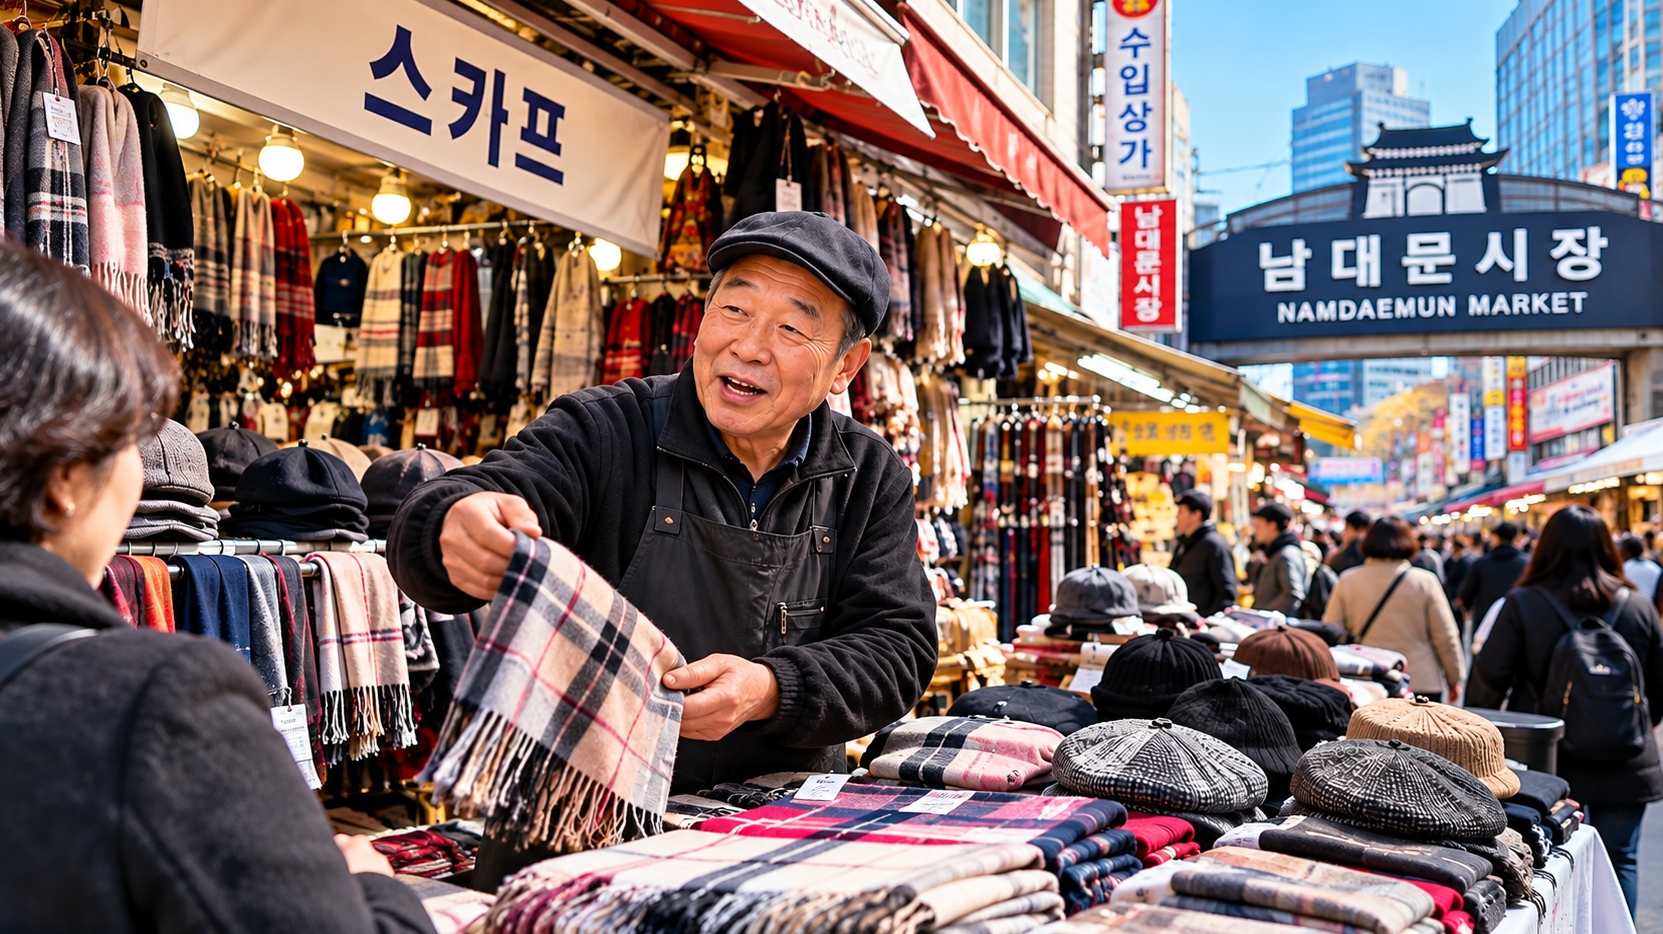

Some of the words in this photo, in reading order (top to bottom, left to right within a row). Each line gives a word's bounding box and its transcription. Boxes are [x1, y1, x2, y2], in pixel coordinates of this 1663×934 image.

[364, 24, 565, 186] 스카프
[1119, 27, 1152, 169] 수입상가
[1133, 204, 1163, 323] 남대문시장
[1259, 226, 1609, 292] 남대문시장
[1277, 296, 1456, 324] NAMDAEMUN
[1468, 291, 1588, 317] MARKET
